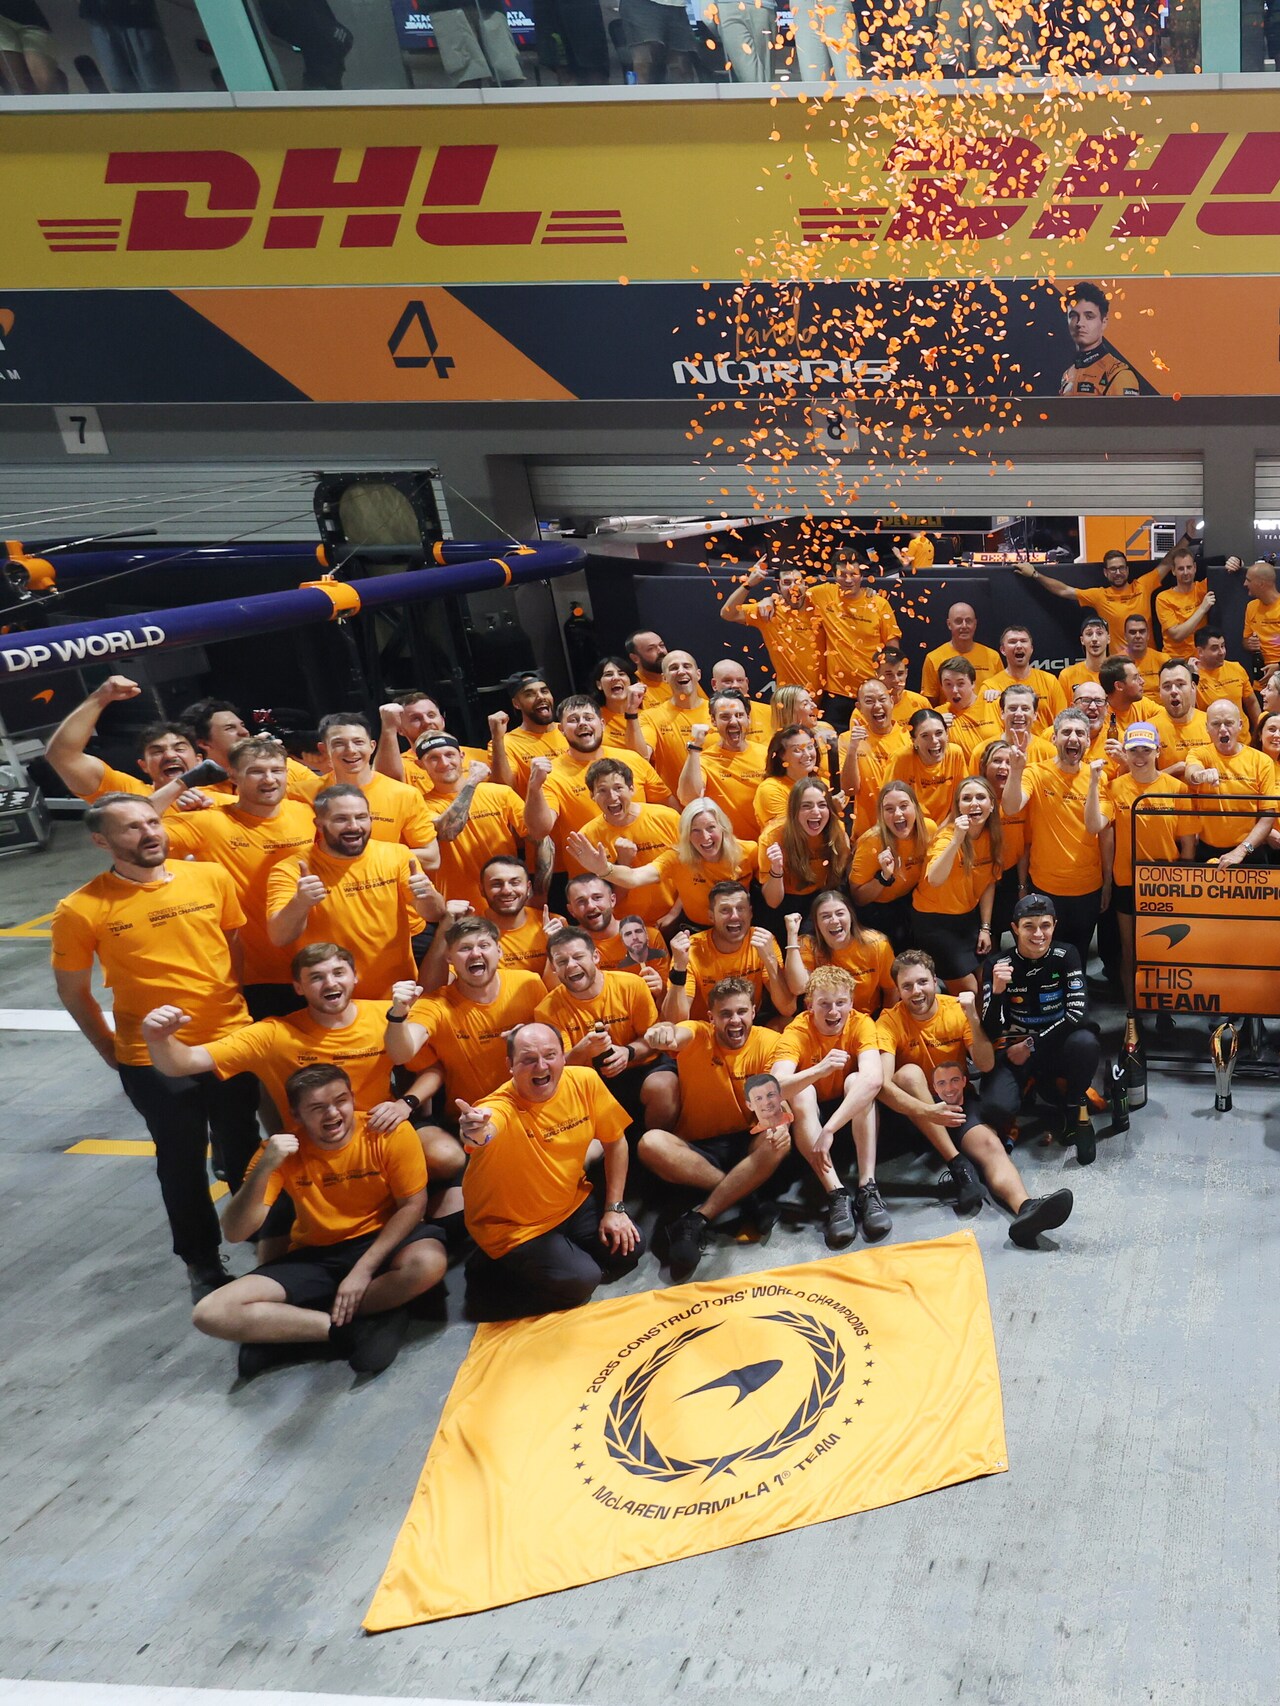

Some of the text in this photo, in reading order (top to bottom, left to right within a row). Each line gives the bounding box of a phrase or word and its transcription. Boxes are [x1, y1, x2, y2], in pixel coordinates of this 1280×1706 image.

[105, 144, 542, 252] DHL
[387, 300, 456, 379] 4
[672, 358, 893, 385] NORRIS
[69, 416, 87, 444] 7
[826, 409, 845, 441] 8
[3, 625, 166, 672] DP WORLD
[1139, 867, 1271, 884] CONSTRUCTORS'
[1139, 883, 1204, 899] WORLD
[149, 902, 216, 923] WORLD CHAMPIONS
[1139, 902, 1174, 912] 2025
[110, 923, 134, 933] TEAM
[1140, 967, 1193, 991] THIS
[1139, 992, 1220, 1012] TEAM
[587, 1285, 869, 1393] 2025 CONSTRUCTORS' WORLD CHAMPIONS
[592, 1485, 671, 1519] McLAREN
[672, 1480, 771, 1520] FORMULA
[793, 1432, 841, 1472] TEAM
